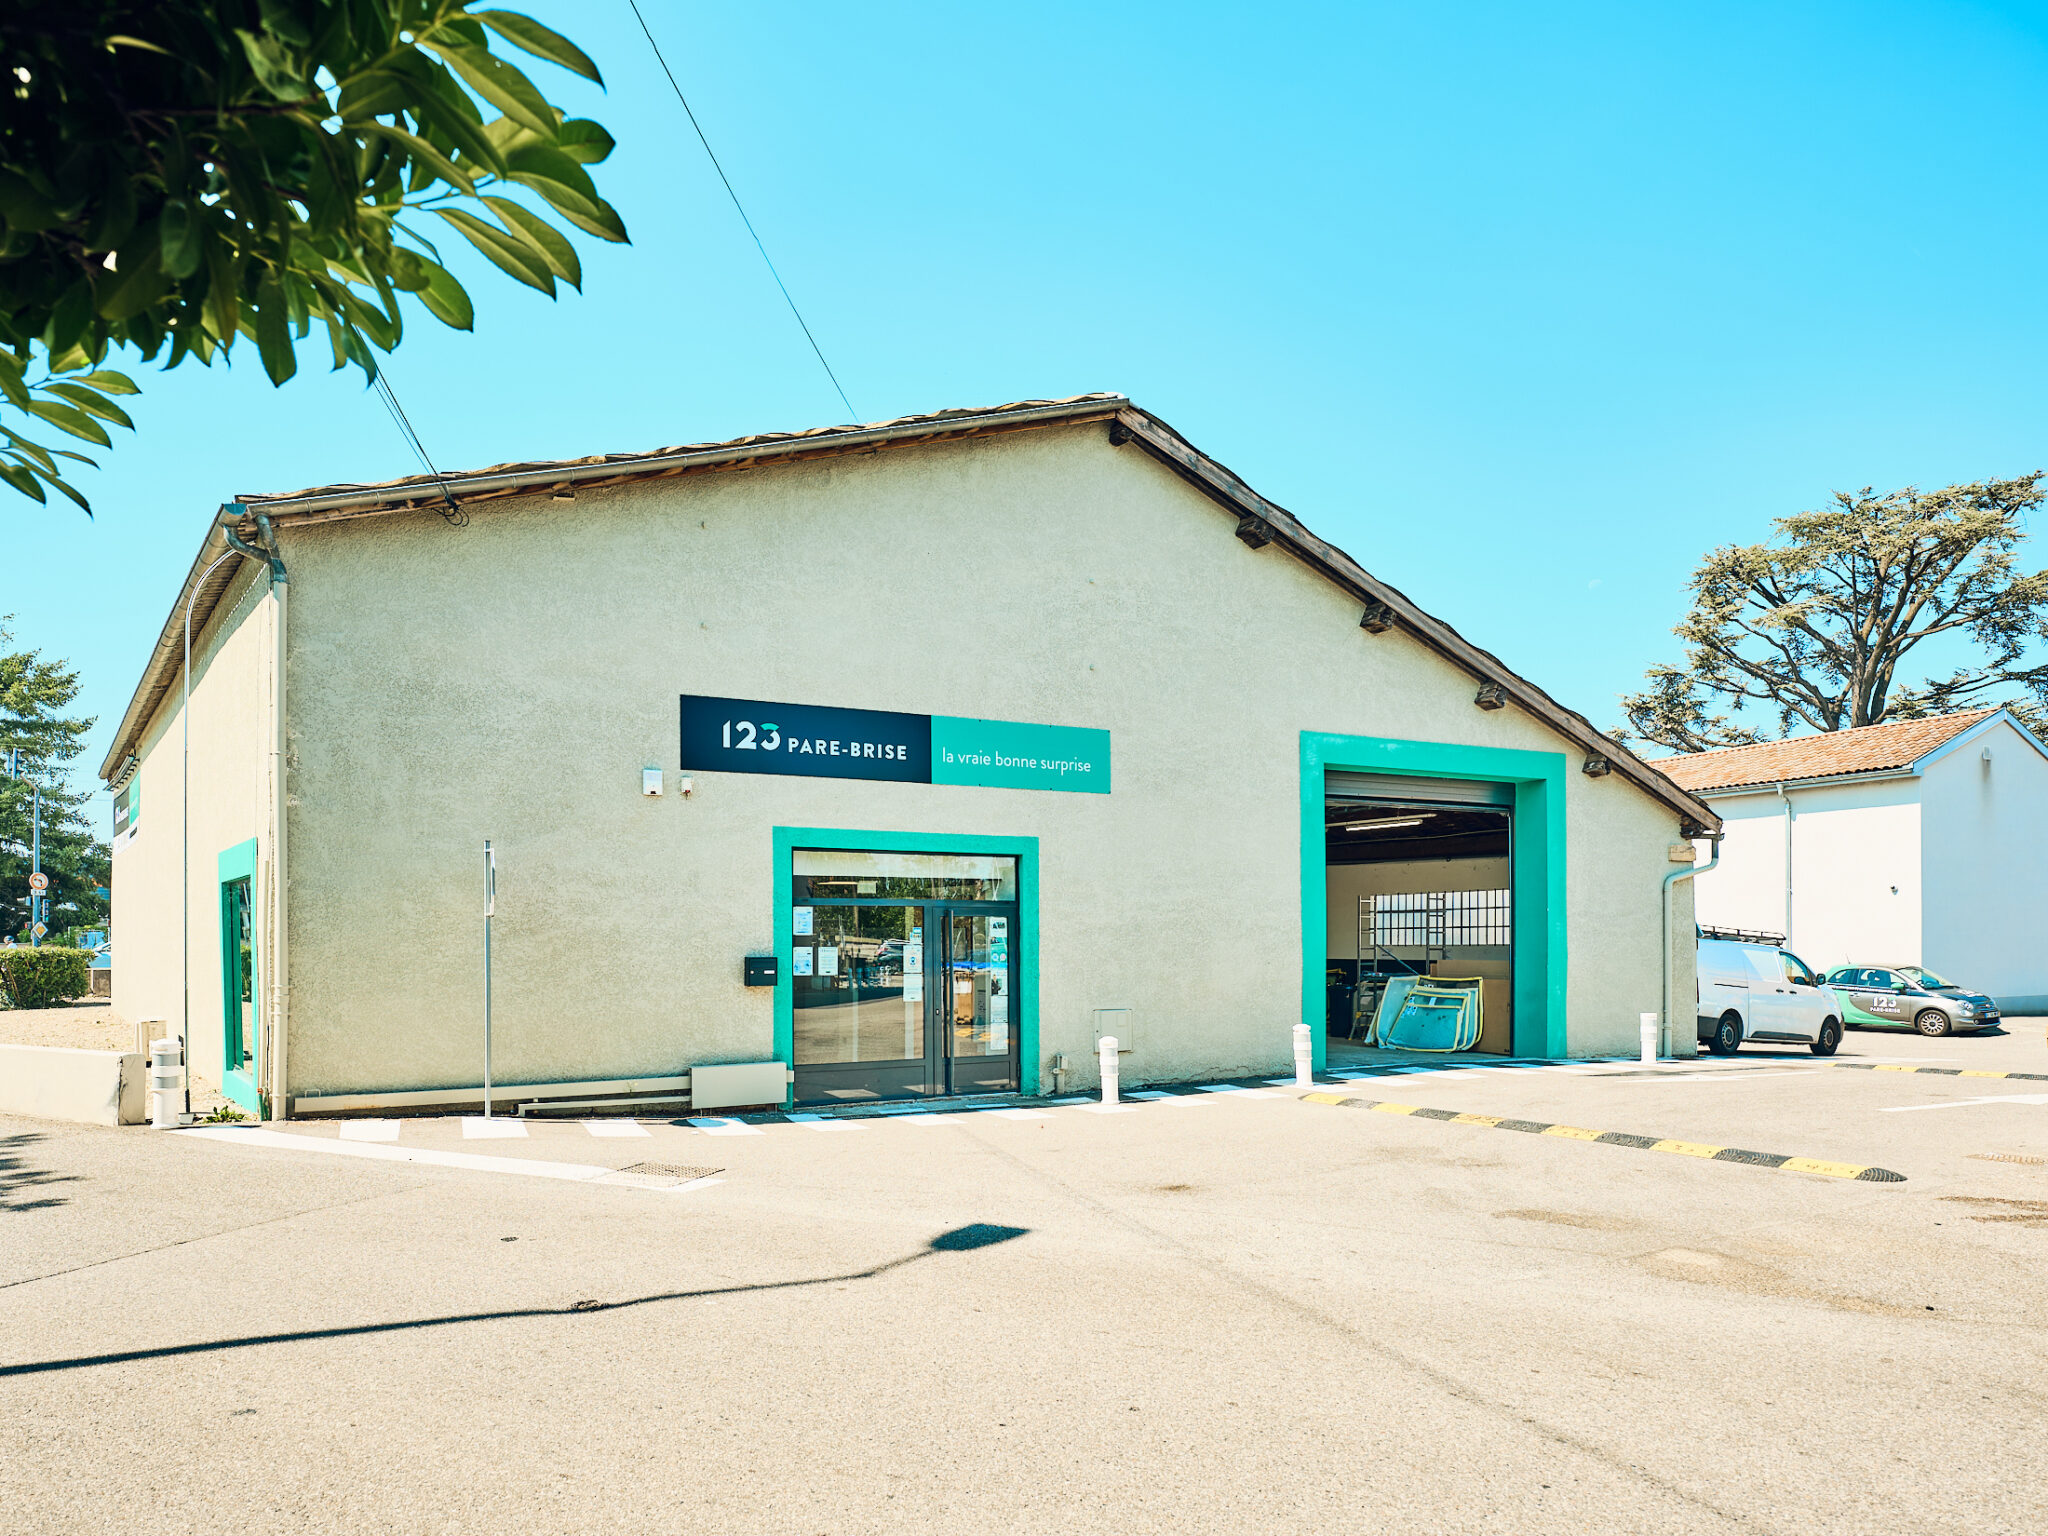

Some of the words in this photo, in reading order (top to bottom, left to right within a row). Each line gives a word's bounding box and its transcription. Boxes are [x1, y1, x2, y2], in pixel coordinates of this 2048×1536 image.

[722, 719, 781, 751] 123
[788, 737, 907, 761] PARE-BRISE
[942, 746, 954, 763] la
[957, 749, 991, 766] vraie
[995, 750, 1037, 768] bonne
[1040, 756, 1092, 776] surprise
[1873, 996, 1897, 1008] 123
